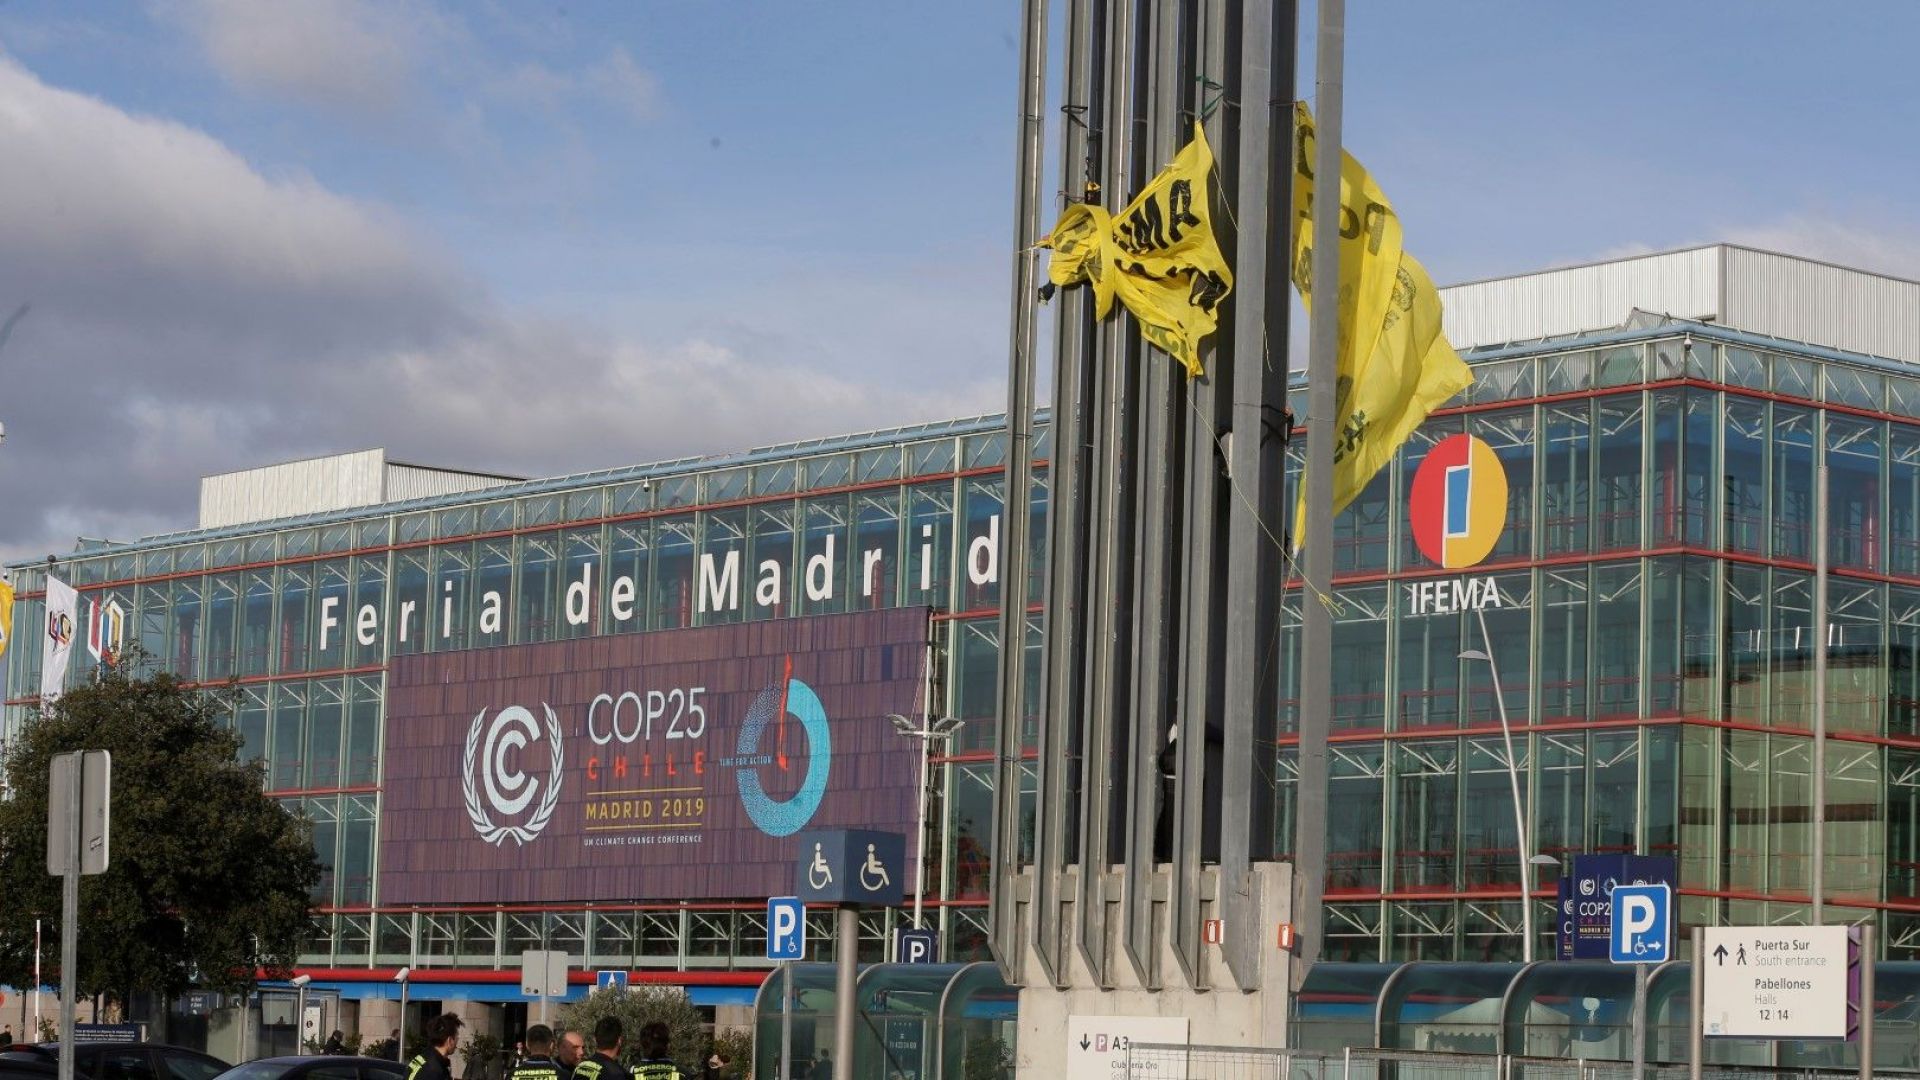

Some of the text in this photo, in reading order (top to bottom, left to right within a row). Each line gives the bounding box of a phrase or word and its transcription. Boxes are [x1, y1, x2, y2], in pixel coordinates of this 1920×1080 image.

[320, 514, 999, 650] Feria de Madrid
[1411, 576, 1501, 614] IFEMA
[588, 687, 706, 745] COP25
[587, 751, 705, 780] CHILE
[585, 798, 704, 820] MADRID 2019
[583, 834, 703, 846] UN CLIMATE CHANGE CONFERENCE
[1579, 902, 1611, 916] COP2
[773, 905, 796, 952] P
[1622, 895, 1656, 954] P
[910, 941, 925, 963] P
[1755, 939, 1810, 951] Puerta Sur
[1755, 956, 1827, 967] South entrance
[1755, 978, 1811, 990] Pabellones
[1754, 994, 1777, 1005] Halls
[1759, 1010, 1789, 1020] 12 14
[1098, 1036, 1129, 1050] P A3
[633, 1064, 677, 1074] BOMBEROS
[1146, 1061, 1158, 1070] Oro
